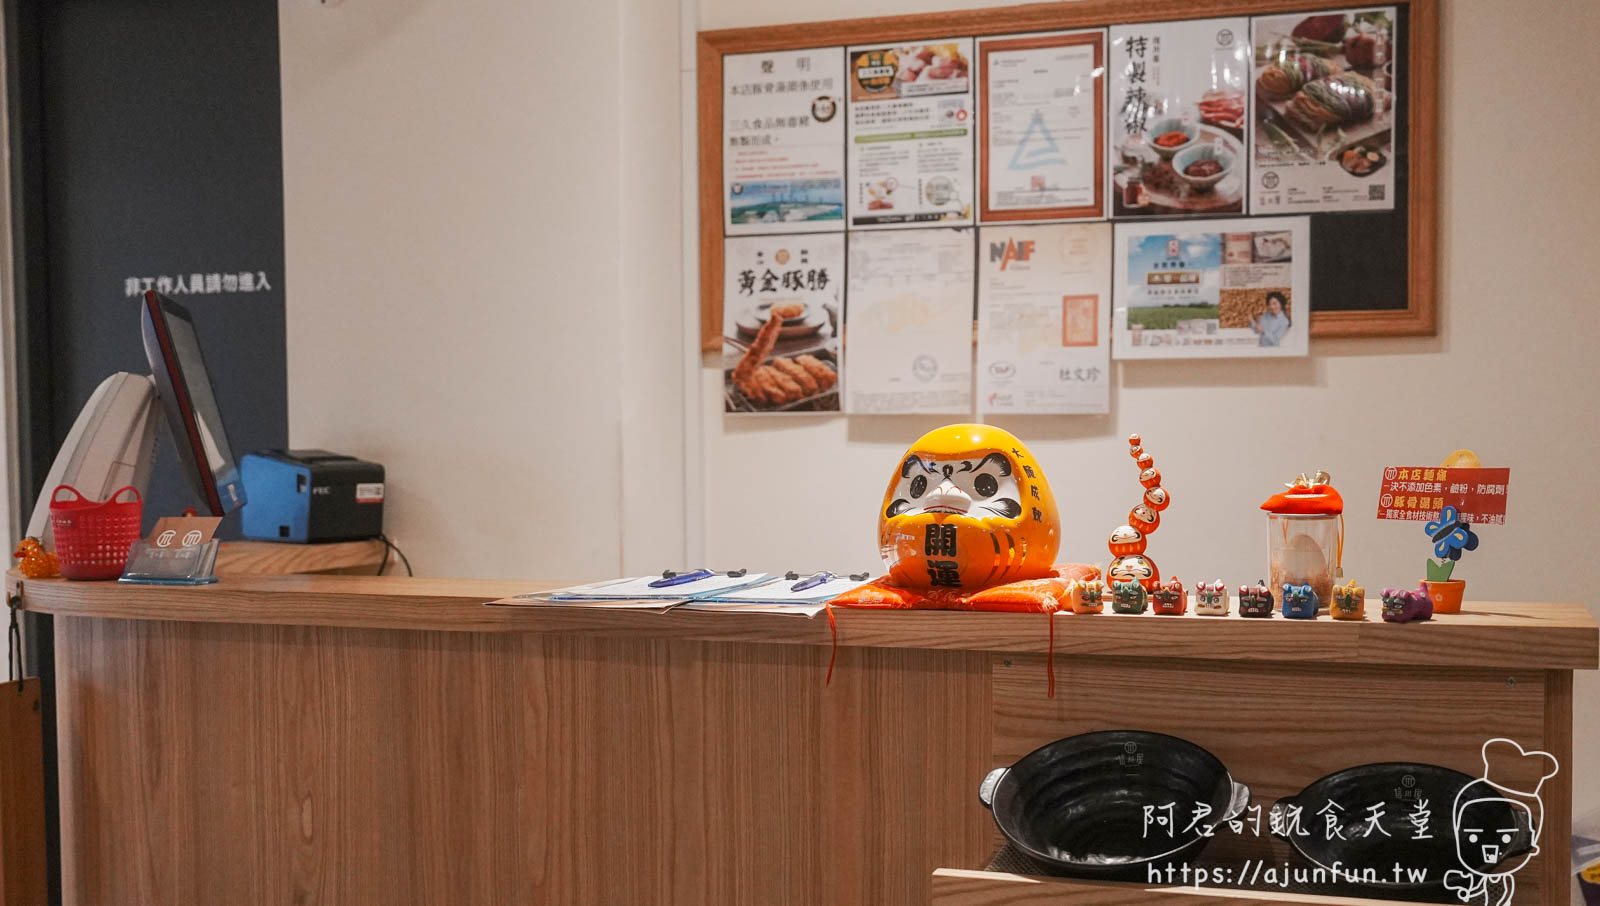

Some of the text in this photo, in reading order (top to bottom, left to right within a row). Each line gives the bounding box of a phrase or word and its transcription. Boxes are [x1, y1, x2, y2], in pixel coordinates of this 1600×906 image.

[990, 238, 1035, 271] NAIF
[125, 271, 271, 297] 非工作人員請勿進入
[925, 523, 962, 587] 開運
